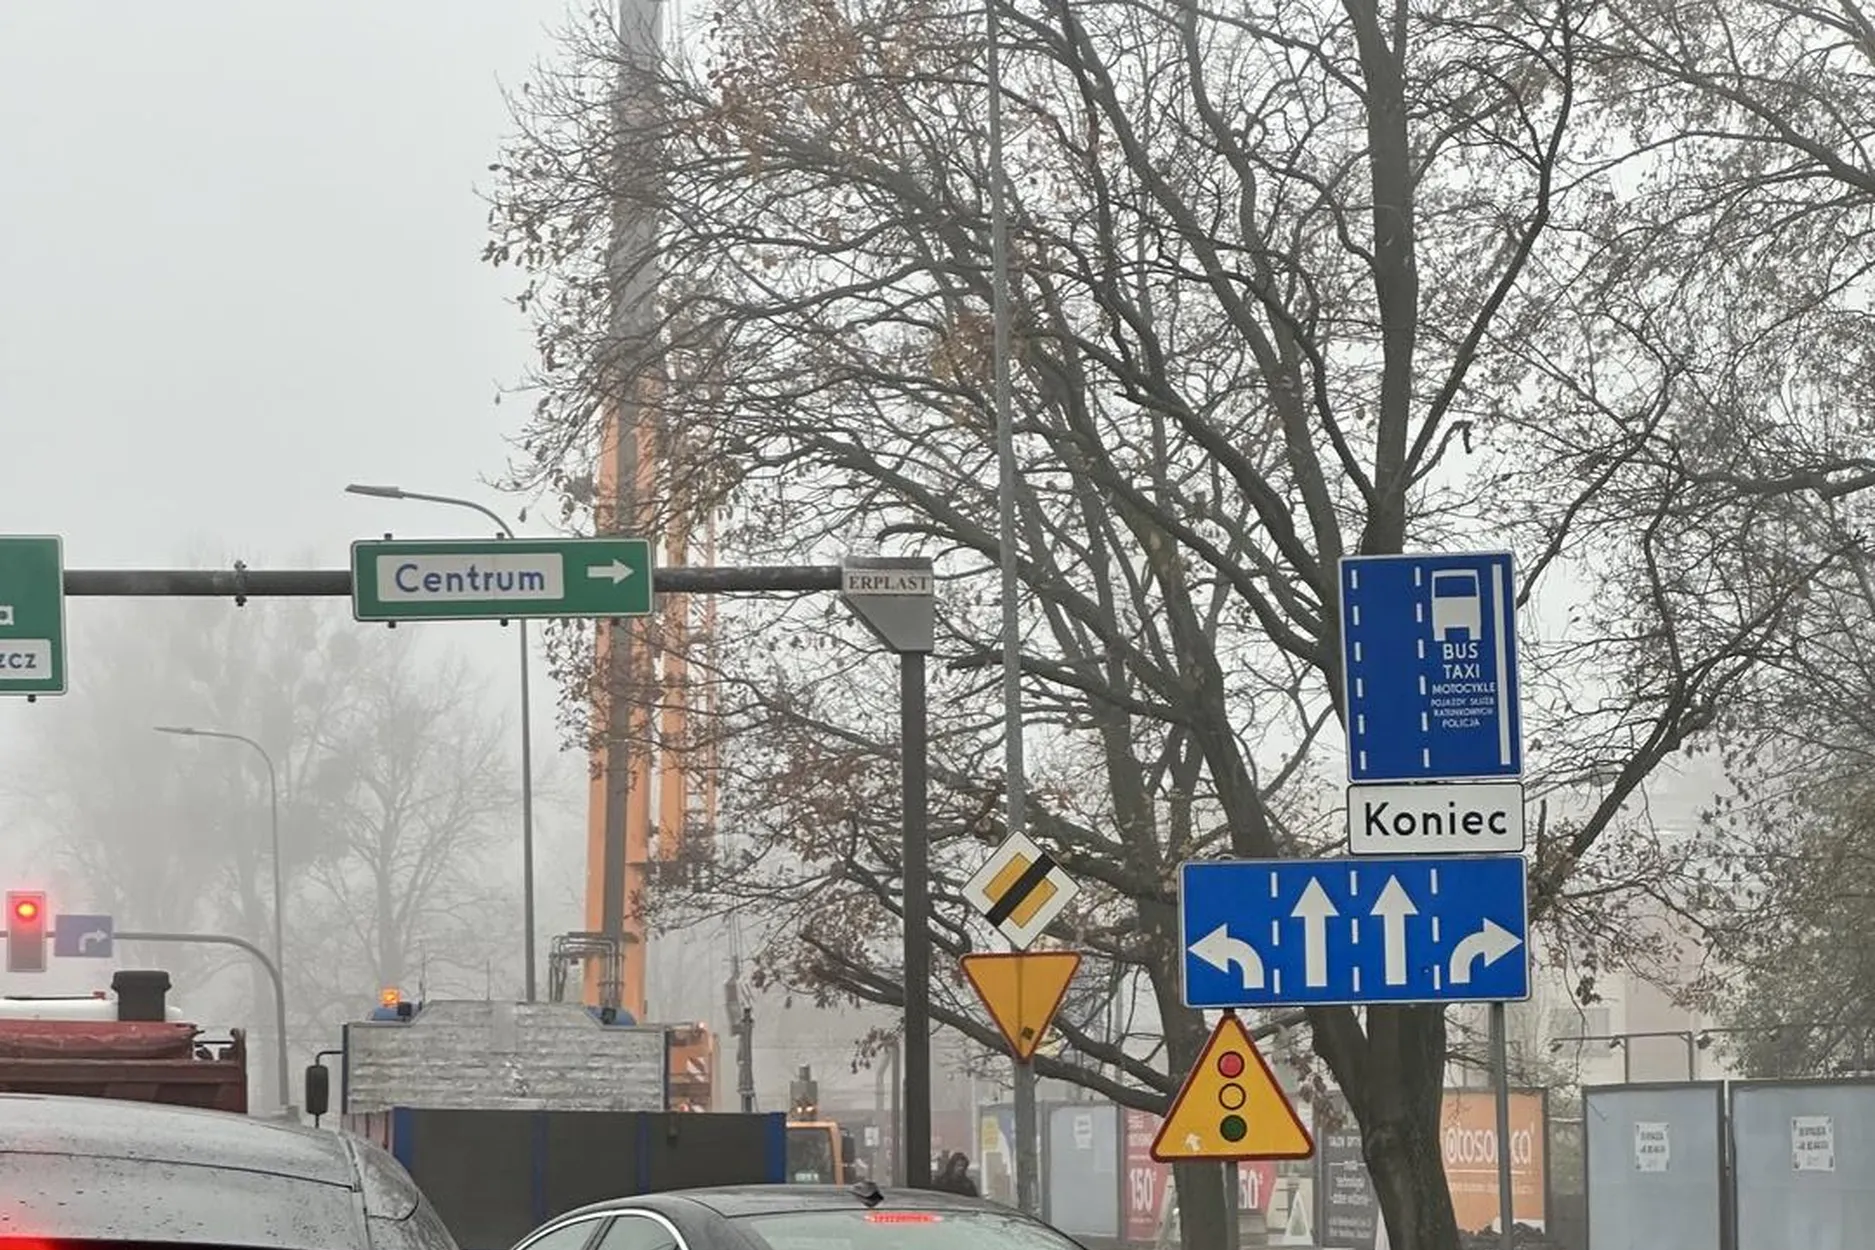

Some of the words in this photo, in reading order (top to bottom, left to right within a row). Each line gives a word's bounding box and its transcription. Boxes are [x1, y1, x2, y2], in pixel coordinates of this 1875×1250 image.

[395, 563, 545, 593] Centrum
[849, 576, 926, 590] ERPLAST
[1443, 643, 1478, 660] BUS
[1443, 663, 1480, 679] TAXI
[1432, 682, 1496, 694] MOTOCYKLE
[1442, 718, 1480, 728] POLICJA
[1365, 801, 1507, 836] Koniec
[1129, 1168, 1154, 1211] 150
[1239, 1170, 1259, 1209] 50
